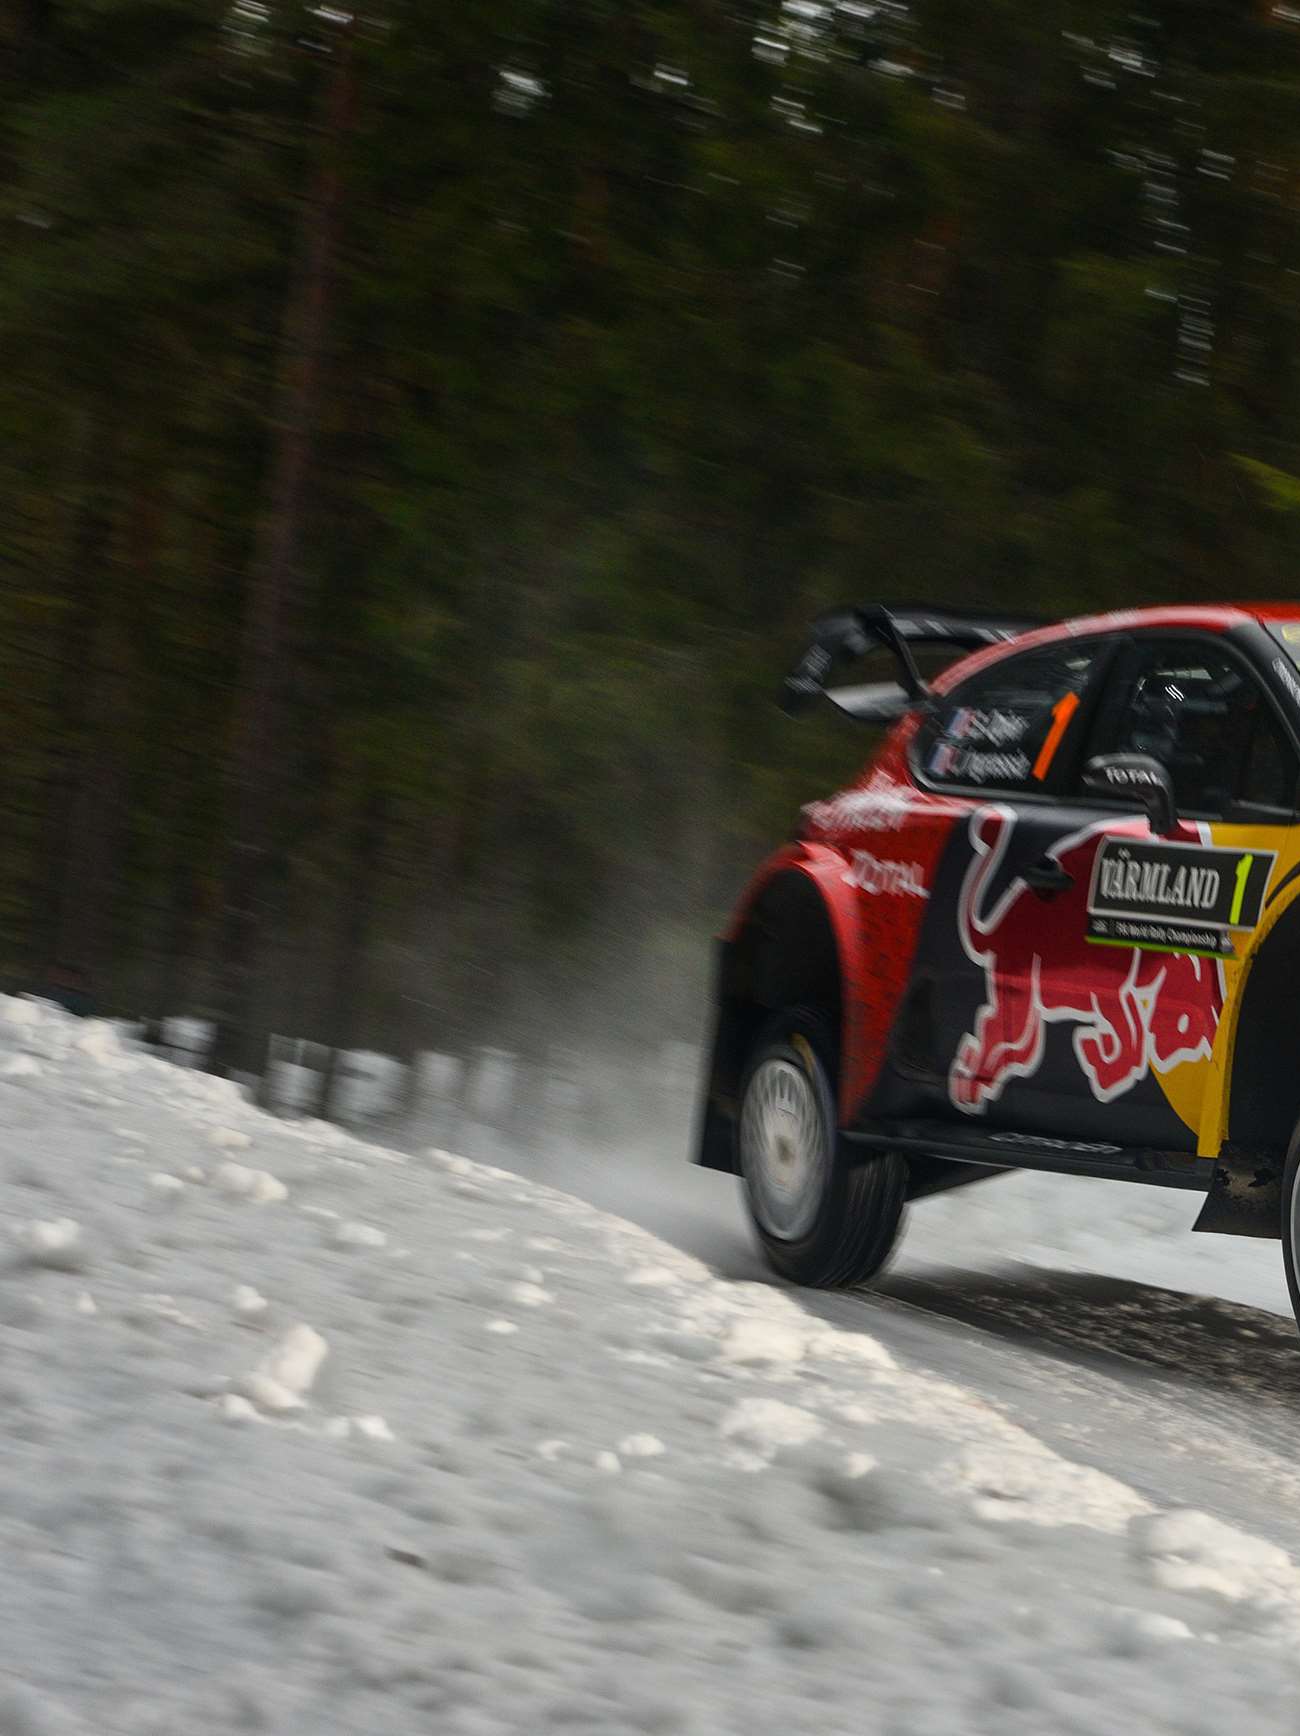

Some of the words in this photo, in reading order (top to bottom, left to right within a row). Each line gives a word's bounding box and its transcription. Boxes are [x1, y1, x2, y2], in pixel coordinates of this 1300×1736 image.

[1031, 691, 1080, 781] 1
[1104, 766, 1164, 786] TOTAL
[1229, 853, 1253, 925] 1
